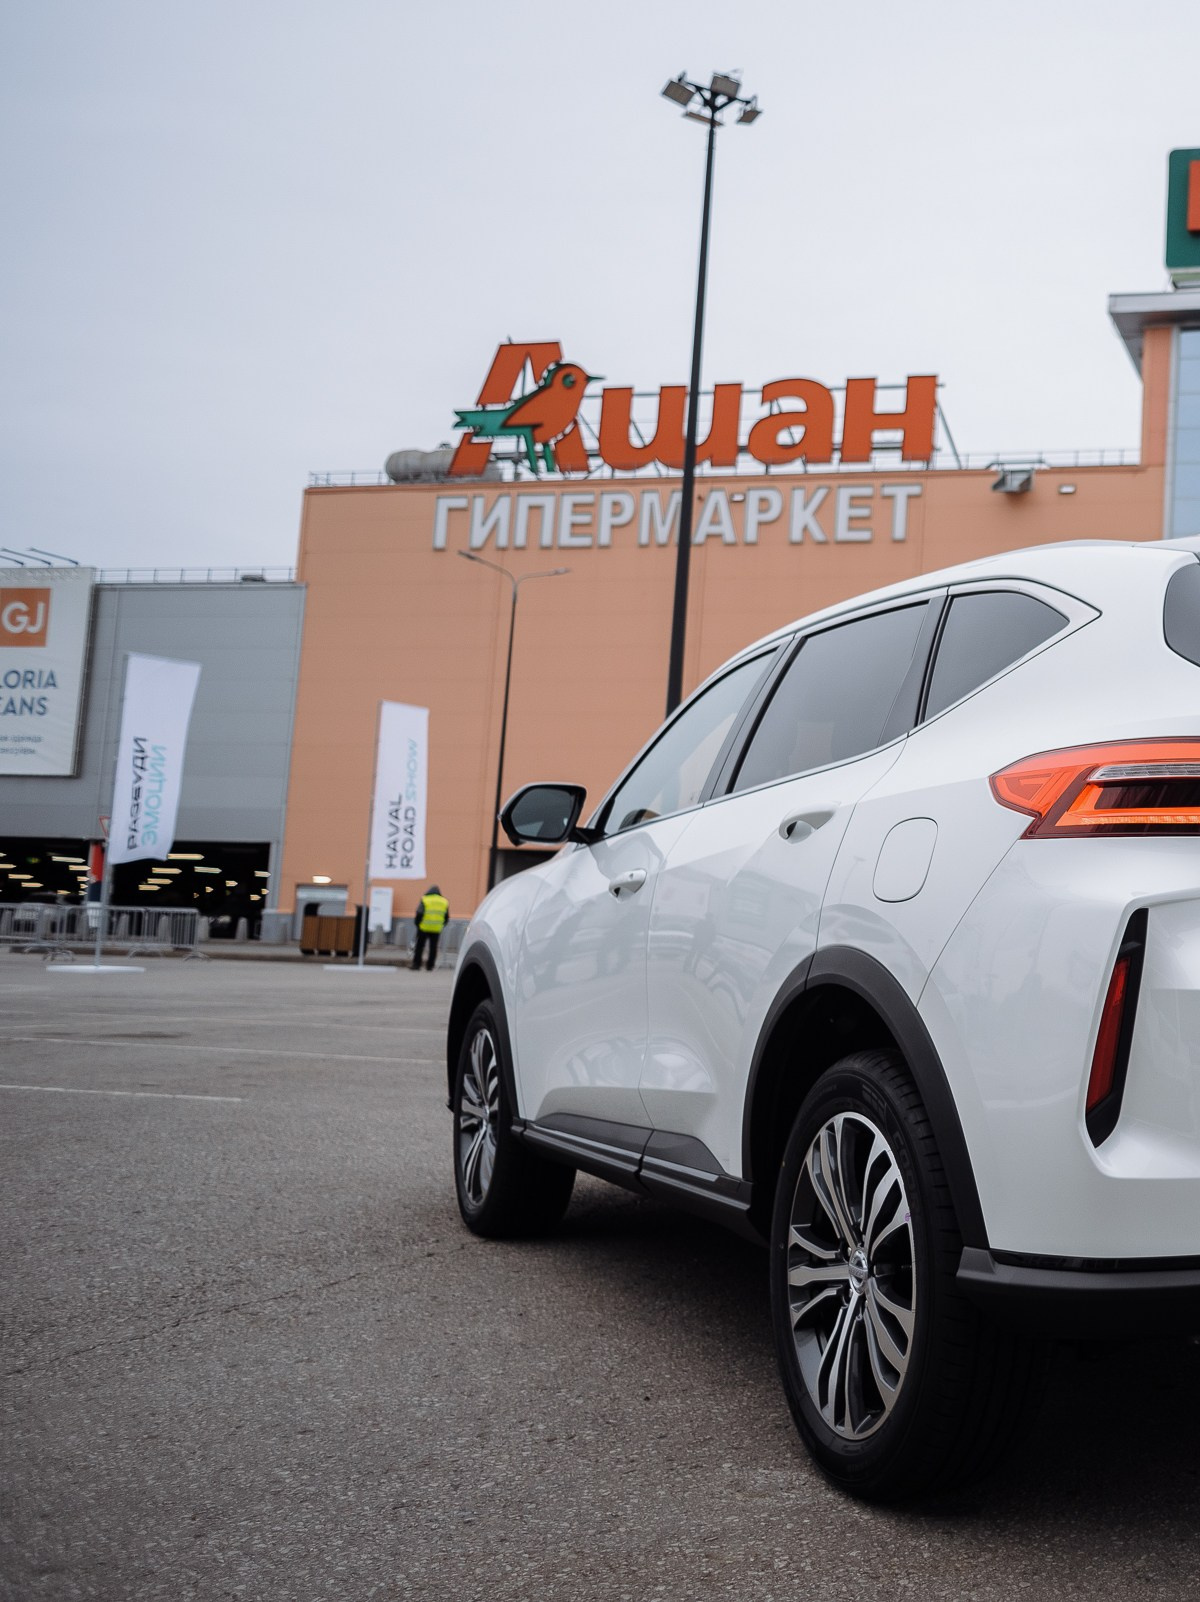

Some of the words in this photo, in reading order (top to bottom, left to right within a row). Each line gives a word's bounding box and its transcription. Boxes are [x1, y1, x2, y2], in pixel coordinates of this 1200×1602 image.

[449, 339, 939, 477] Ашан
[431, 484, 923, 551] ГИПЕРМАРКЕТ
[1, 601, 47, 634] GJ
[0, 670, 57, 689] ORIA
[405, 738, 418, 801] SHOW
[385, 792, 402, 870] HAVAL
[400, 806, 416, 870] ROAD
